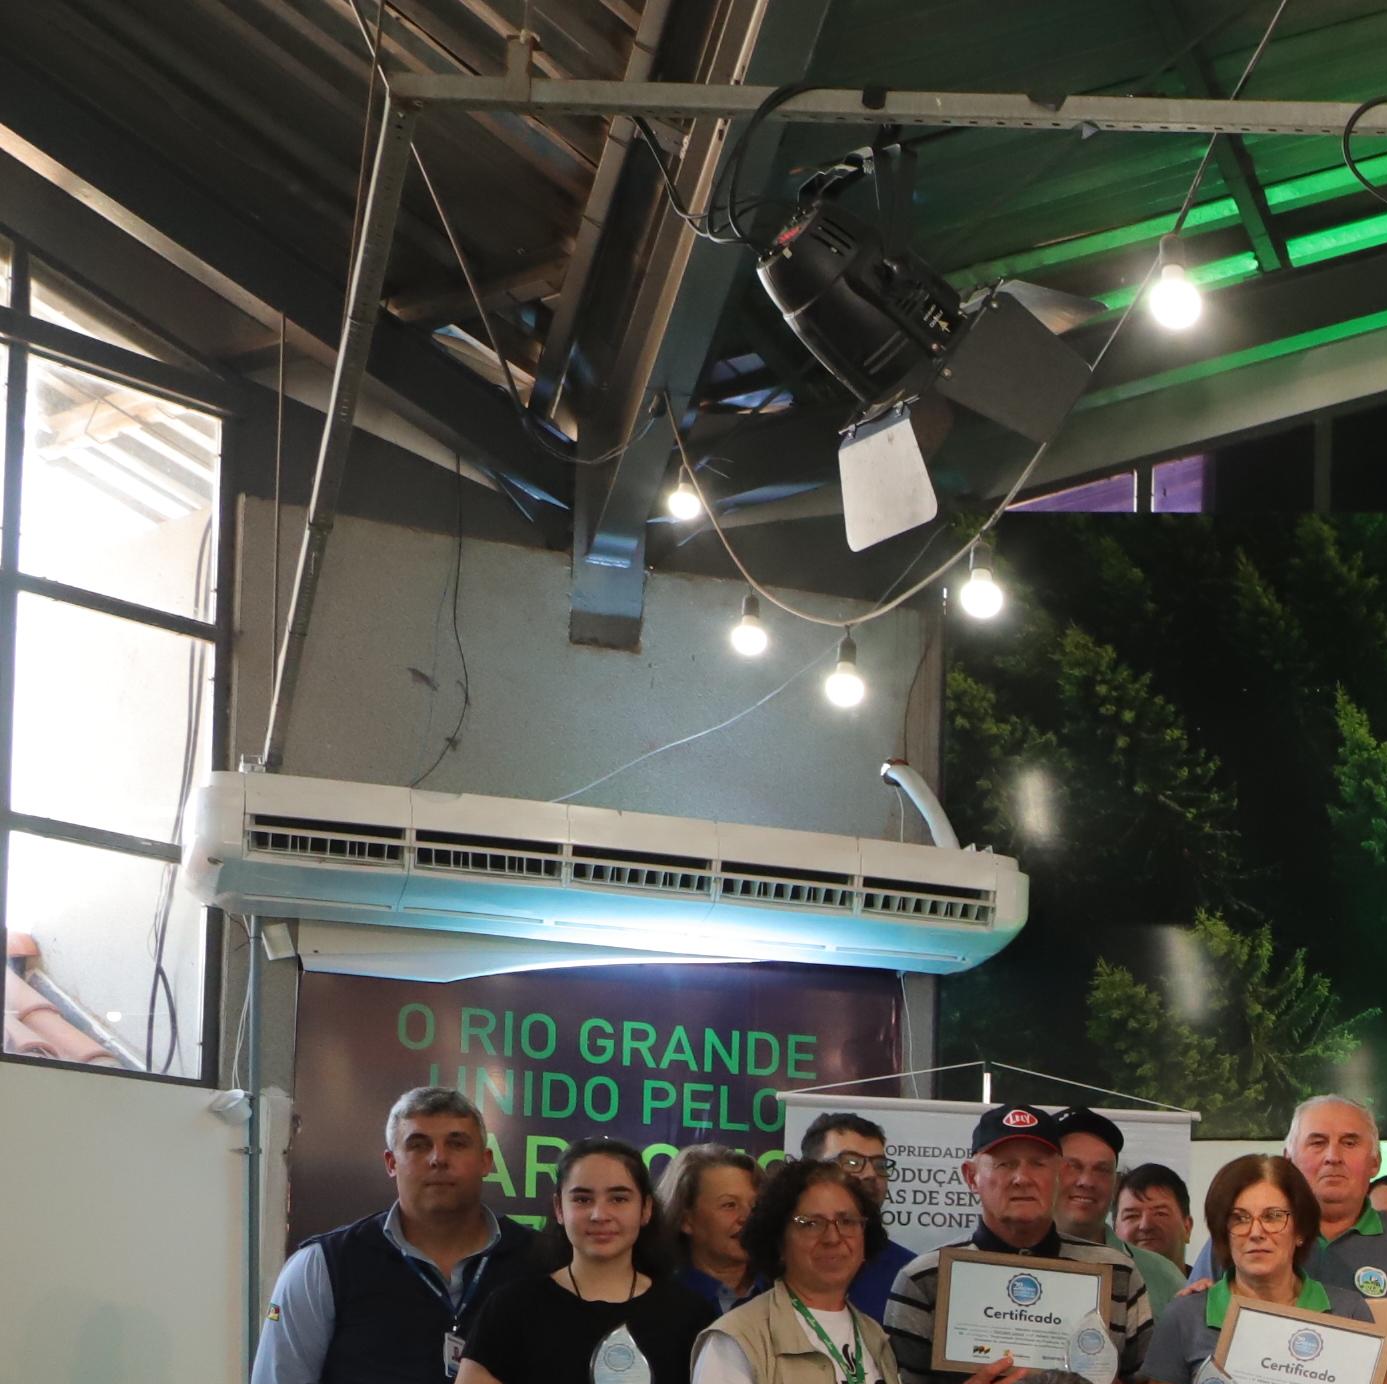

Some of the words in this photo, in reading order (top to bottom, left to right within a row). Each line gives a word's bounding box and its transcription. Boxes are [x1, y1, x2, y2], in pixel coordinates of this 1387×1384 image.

[398, 1003, 436, 1050] O
[460, 1007, 557, 1060] RIO
[580, 1018, 818, 1080] GRANDE
[642, 1080, 786, 1132] PELO
[911, 1189, 940, 1206] DE
[881, 1210, 912, 1227] OU
[983, 1306, 1062, 1325] Certificado
[1261, 1357, 1336, 1383] Certificado
